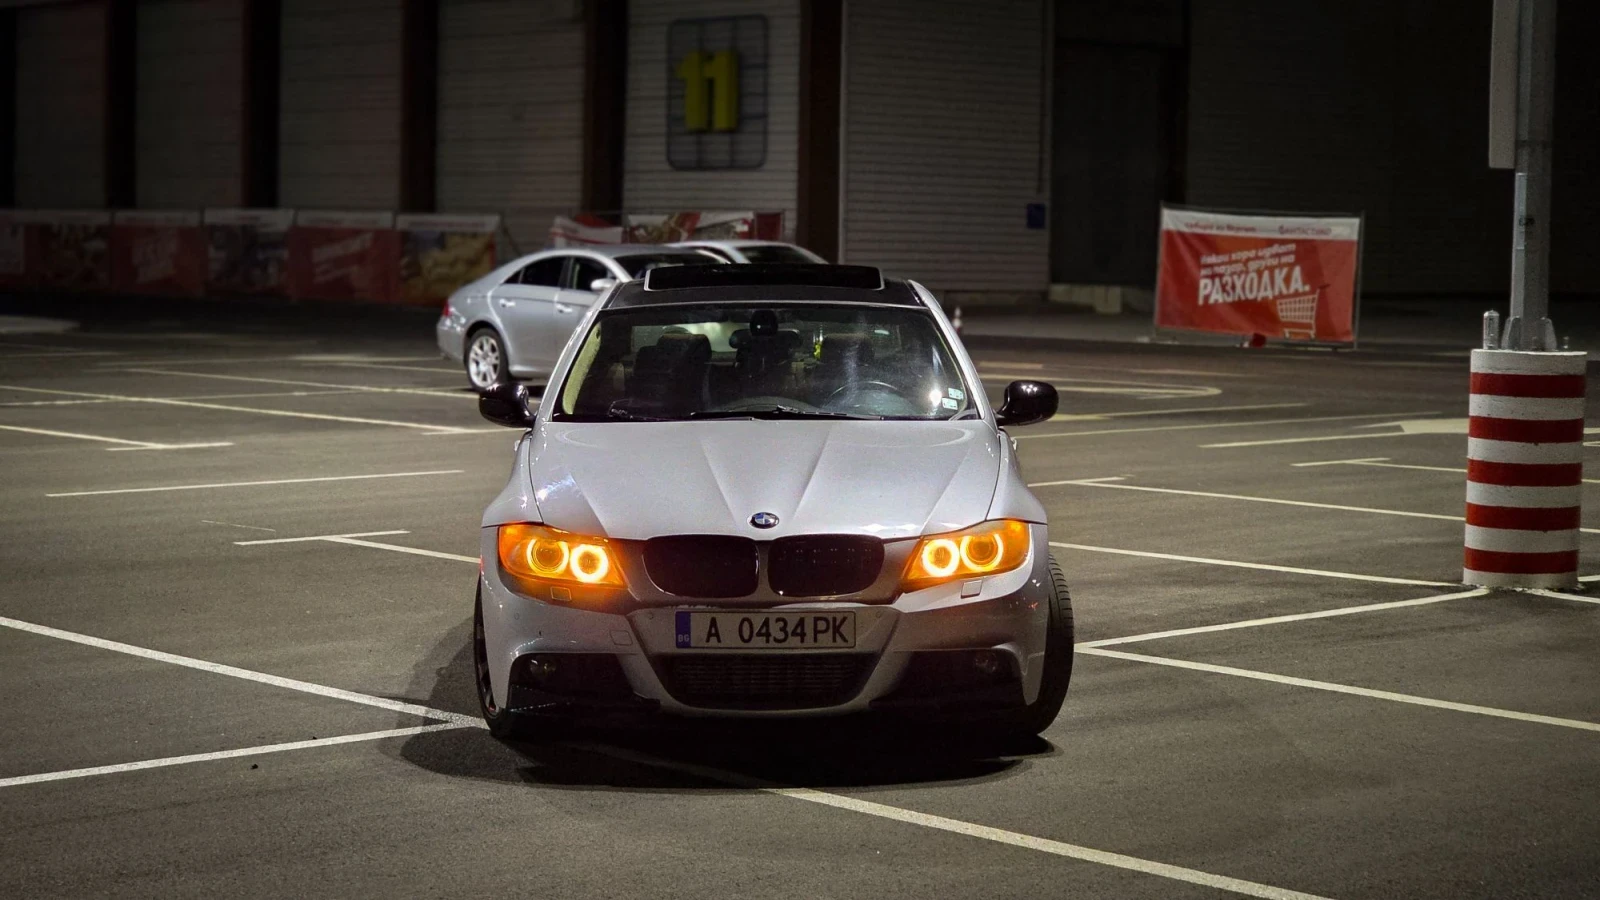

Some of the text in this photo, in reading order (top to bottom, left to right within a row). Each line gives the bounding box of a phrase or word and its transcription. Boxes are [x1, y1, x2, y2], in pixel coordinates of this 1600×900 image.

[675, 50, 738, 132] 11
[1198, 265, 1310, 305] РАЗХОДКА.
[678, 634, 690, 643] BG
[705, 616, 721, 644] A
